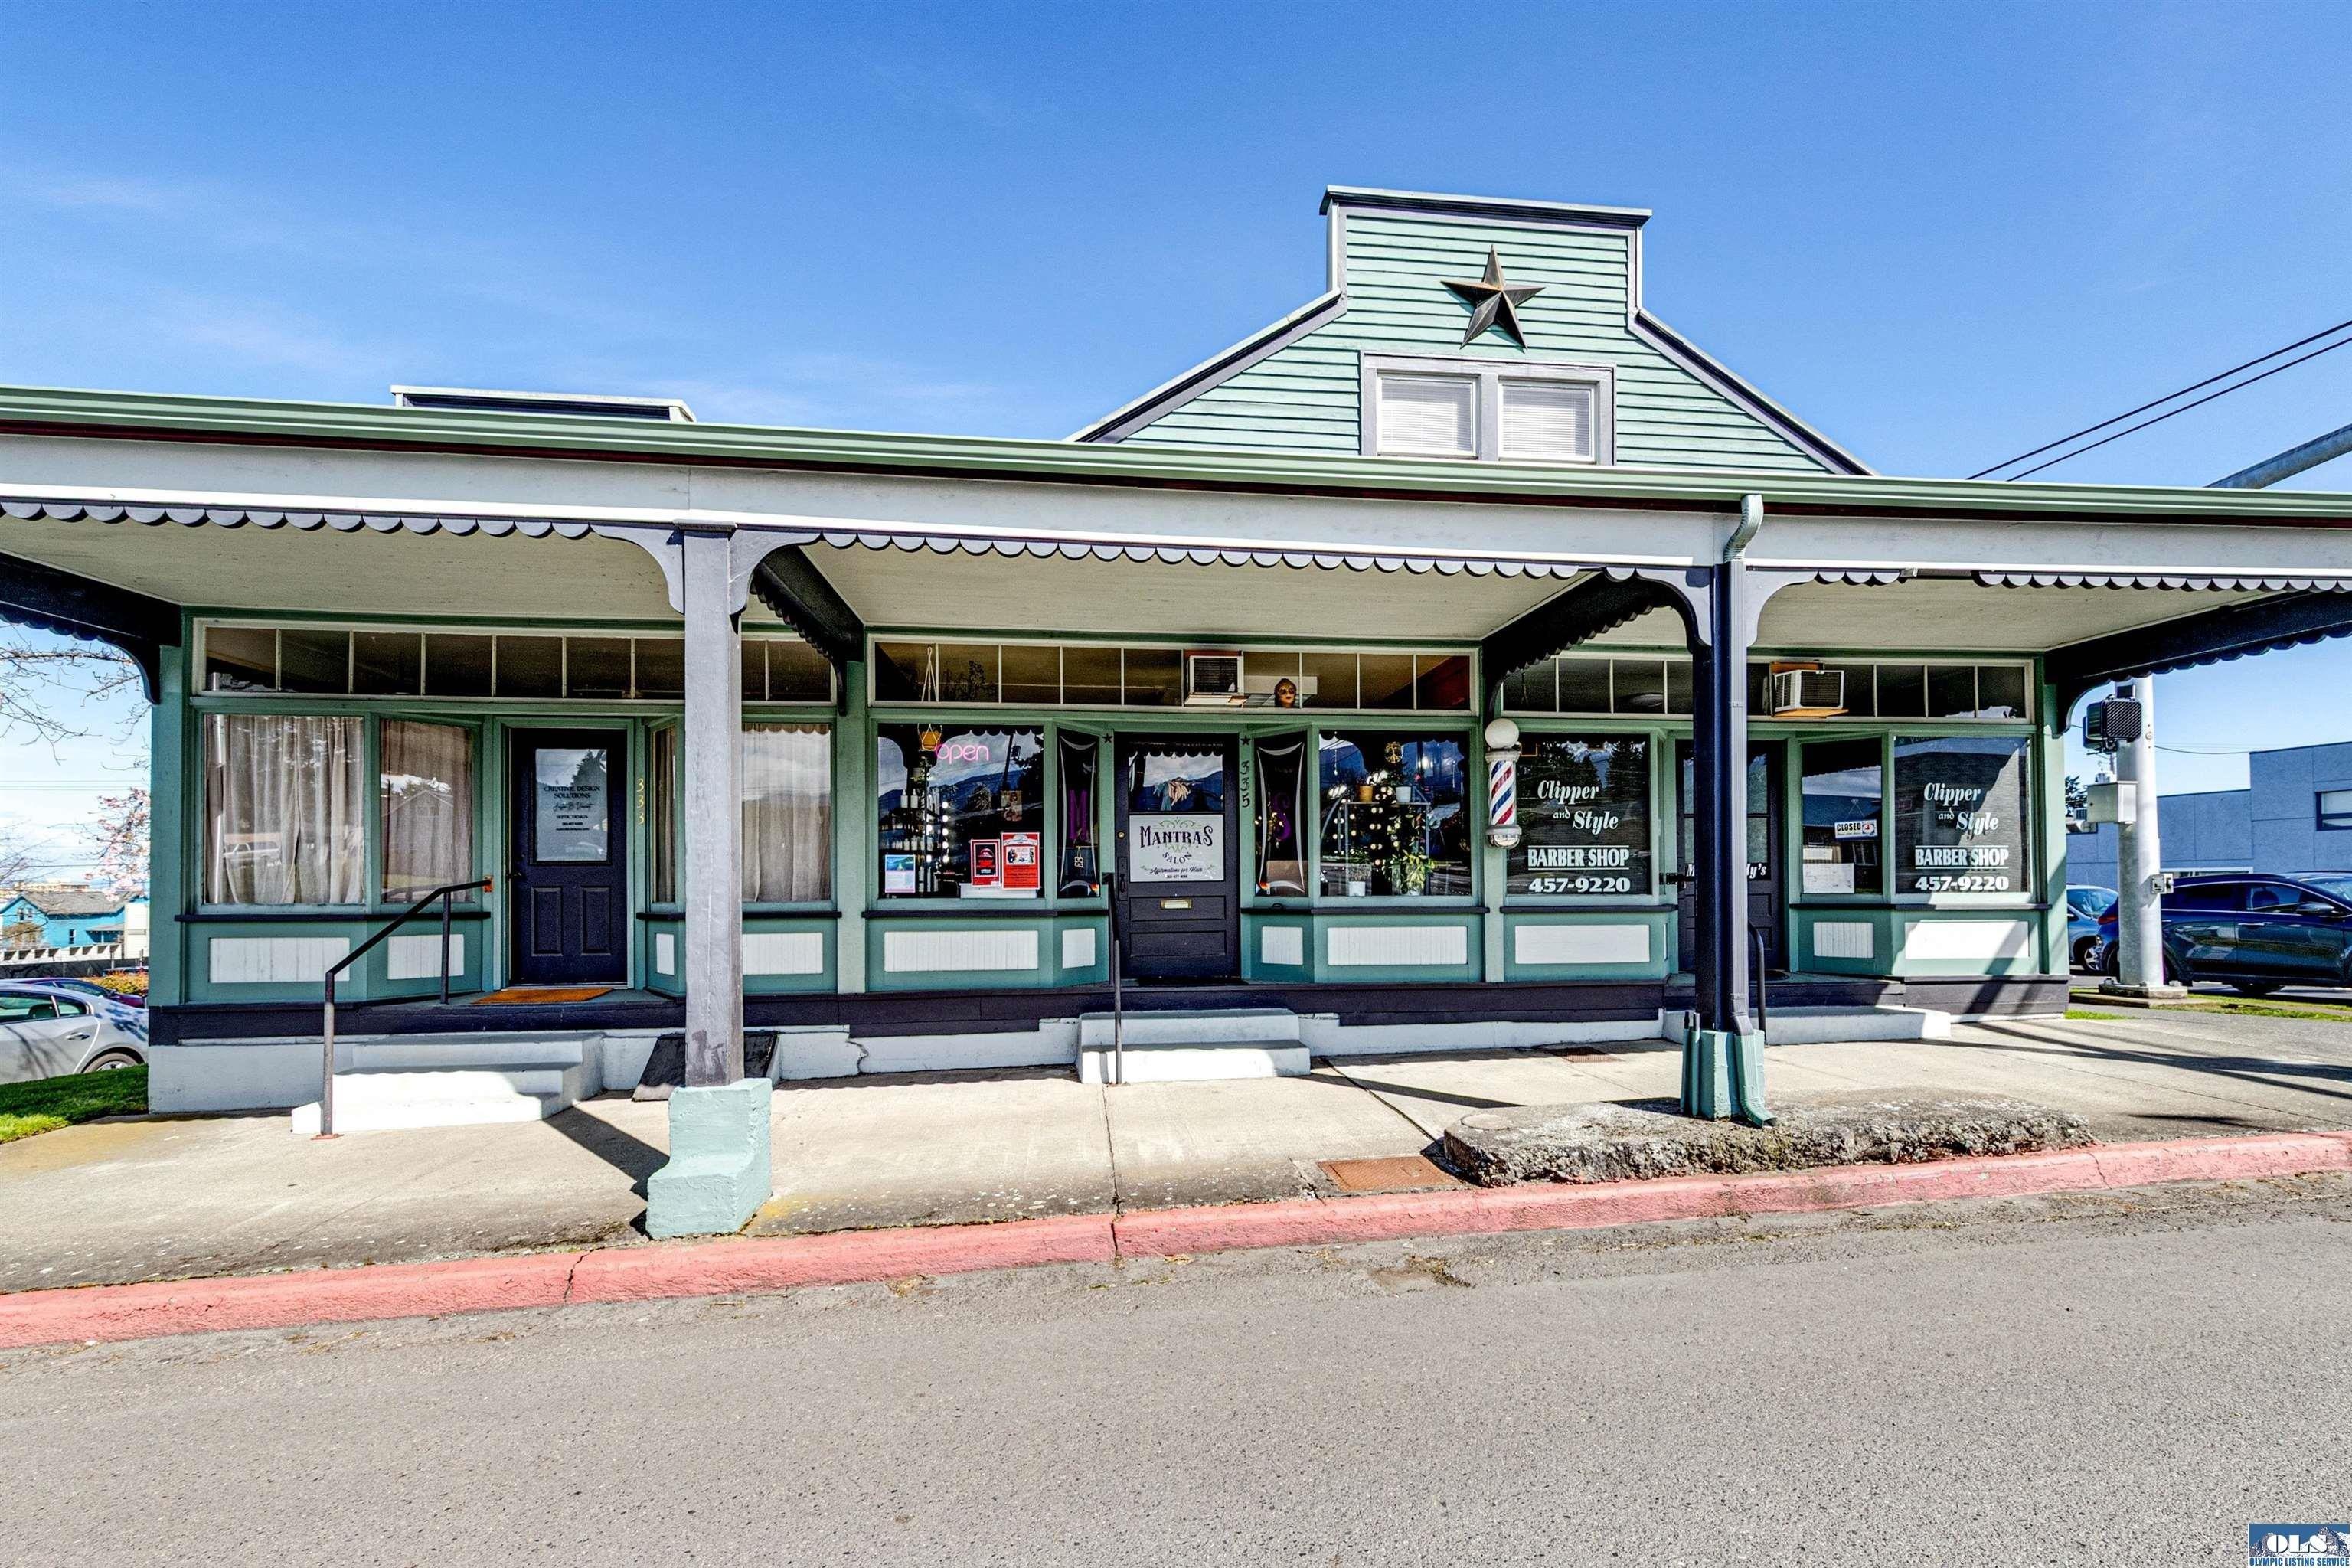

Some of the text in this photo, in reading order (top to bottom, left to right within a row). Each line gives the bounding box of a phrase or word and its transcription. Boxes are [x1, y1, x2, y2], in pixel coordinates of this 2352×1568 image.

[936, 744, 989, 764] open
[1240, 760, 1250, 808] 335
[1537, 780, 1599, 805] Clipper
[1923, 782, 1981, 806] Clipper
[1553, 806, 1619, 835] and Style
[1837, 822, 1860, 831] CLOSED
[1938, 808, 1999, 835] and Style
[1140, 825, 1214, 848] MANTRAS
[1162, 851, 1192, 864] SALON
[1527, 848, 1629, 867] BARBER SHOP
[1915, 848, 2009, 866] BARBER SHOP
[1528, 877, 1631, 893] 457-9220
[1915, 876, 2009, 891] 457-9220
